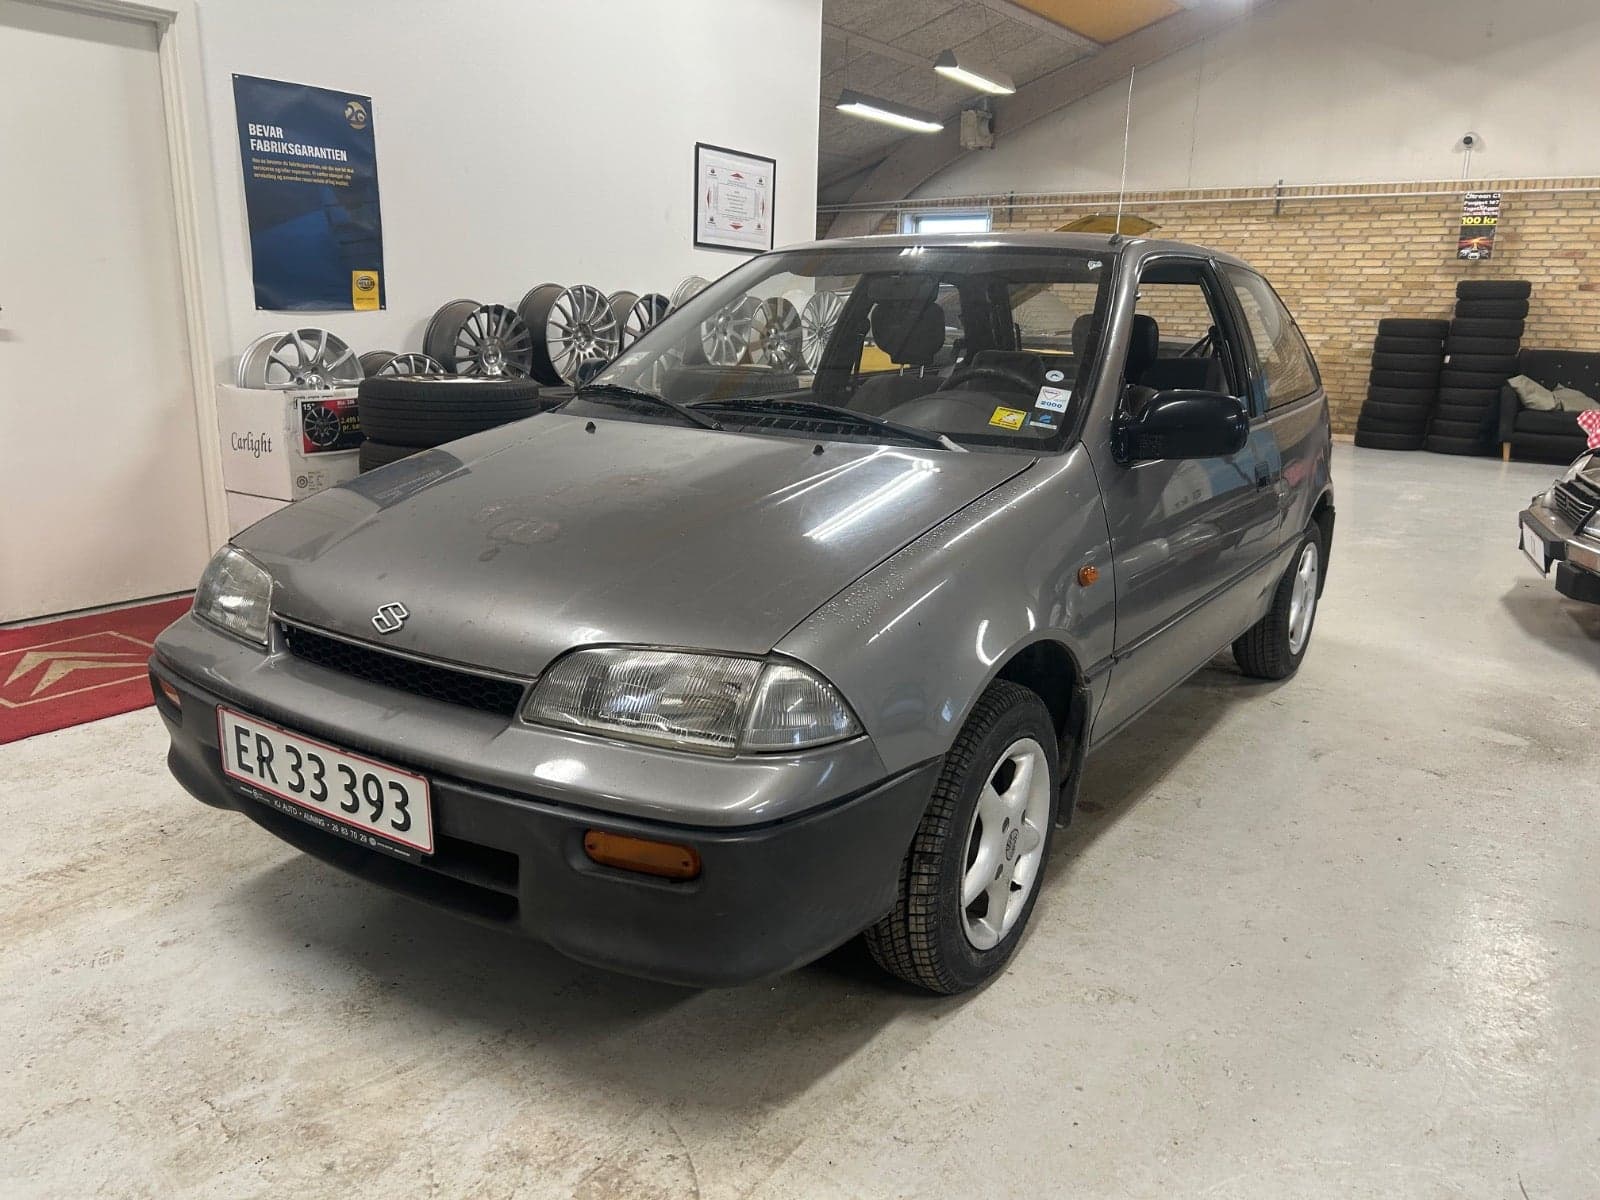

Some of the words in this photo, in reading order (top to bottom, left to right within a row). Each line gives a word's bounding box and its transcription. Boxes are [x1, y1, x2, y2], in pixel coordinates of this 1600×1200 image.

[249, 123, 284, 139] BEVAR
[250, 139, 348, 162] FABRIKSGARANTIEN
[1462, 216, 1481, 224] 100
[1483, 216, 1497, 224] kr
[1040, 400, 1063, 409] 2000
[231, 431, 273, 459] Carlight
[234, 725, 279, 785] ER
[286, 744, 329, 802] 33
[337, 763, 412, 832] 393
[282, 803, 298, 815] AUTO
